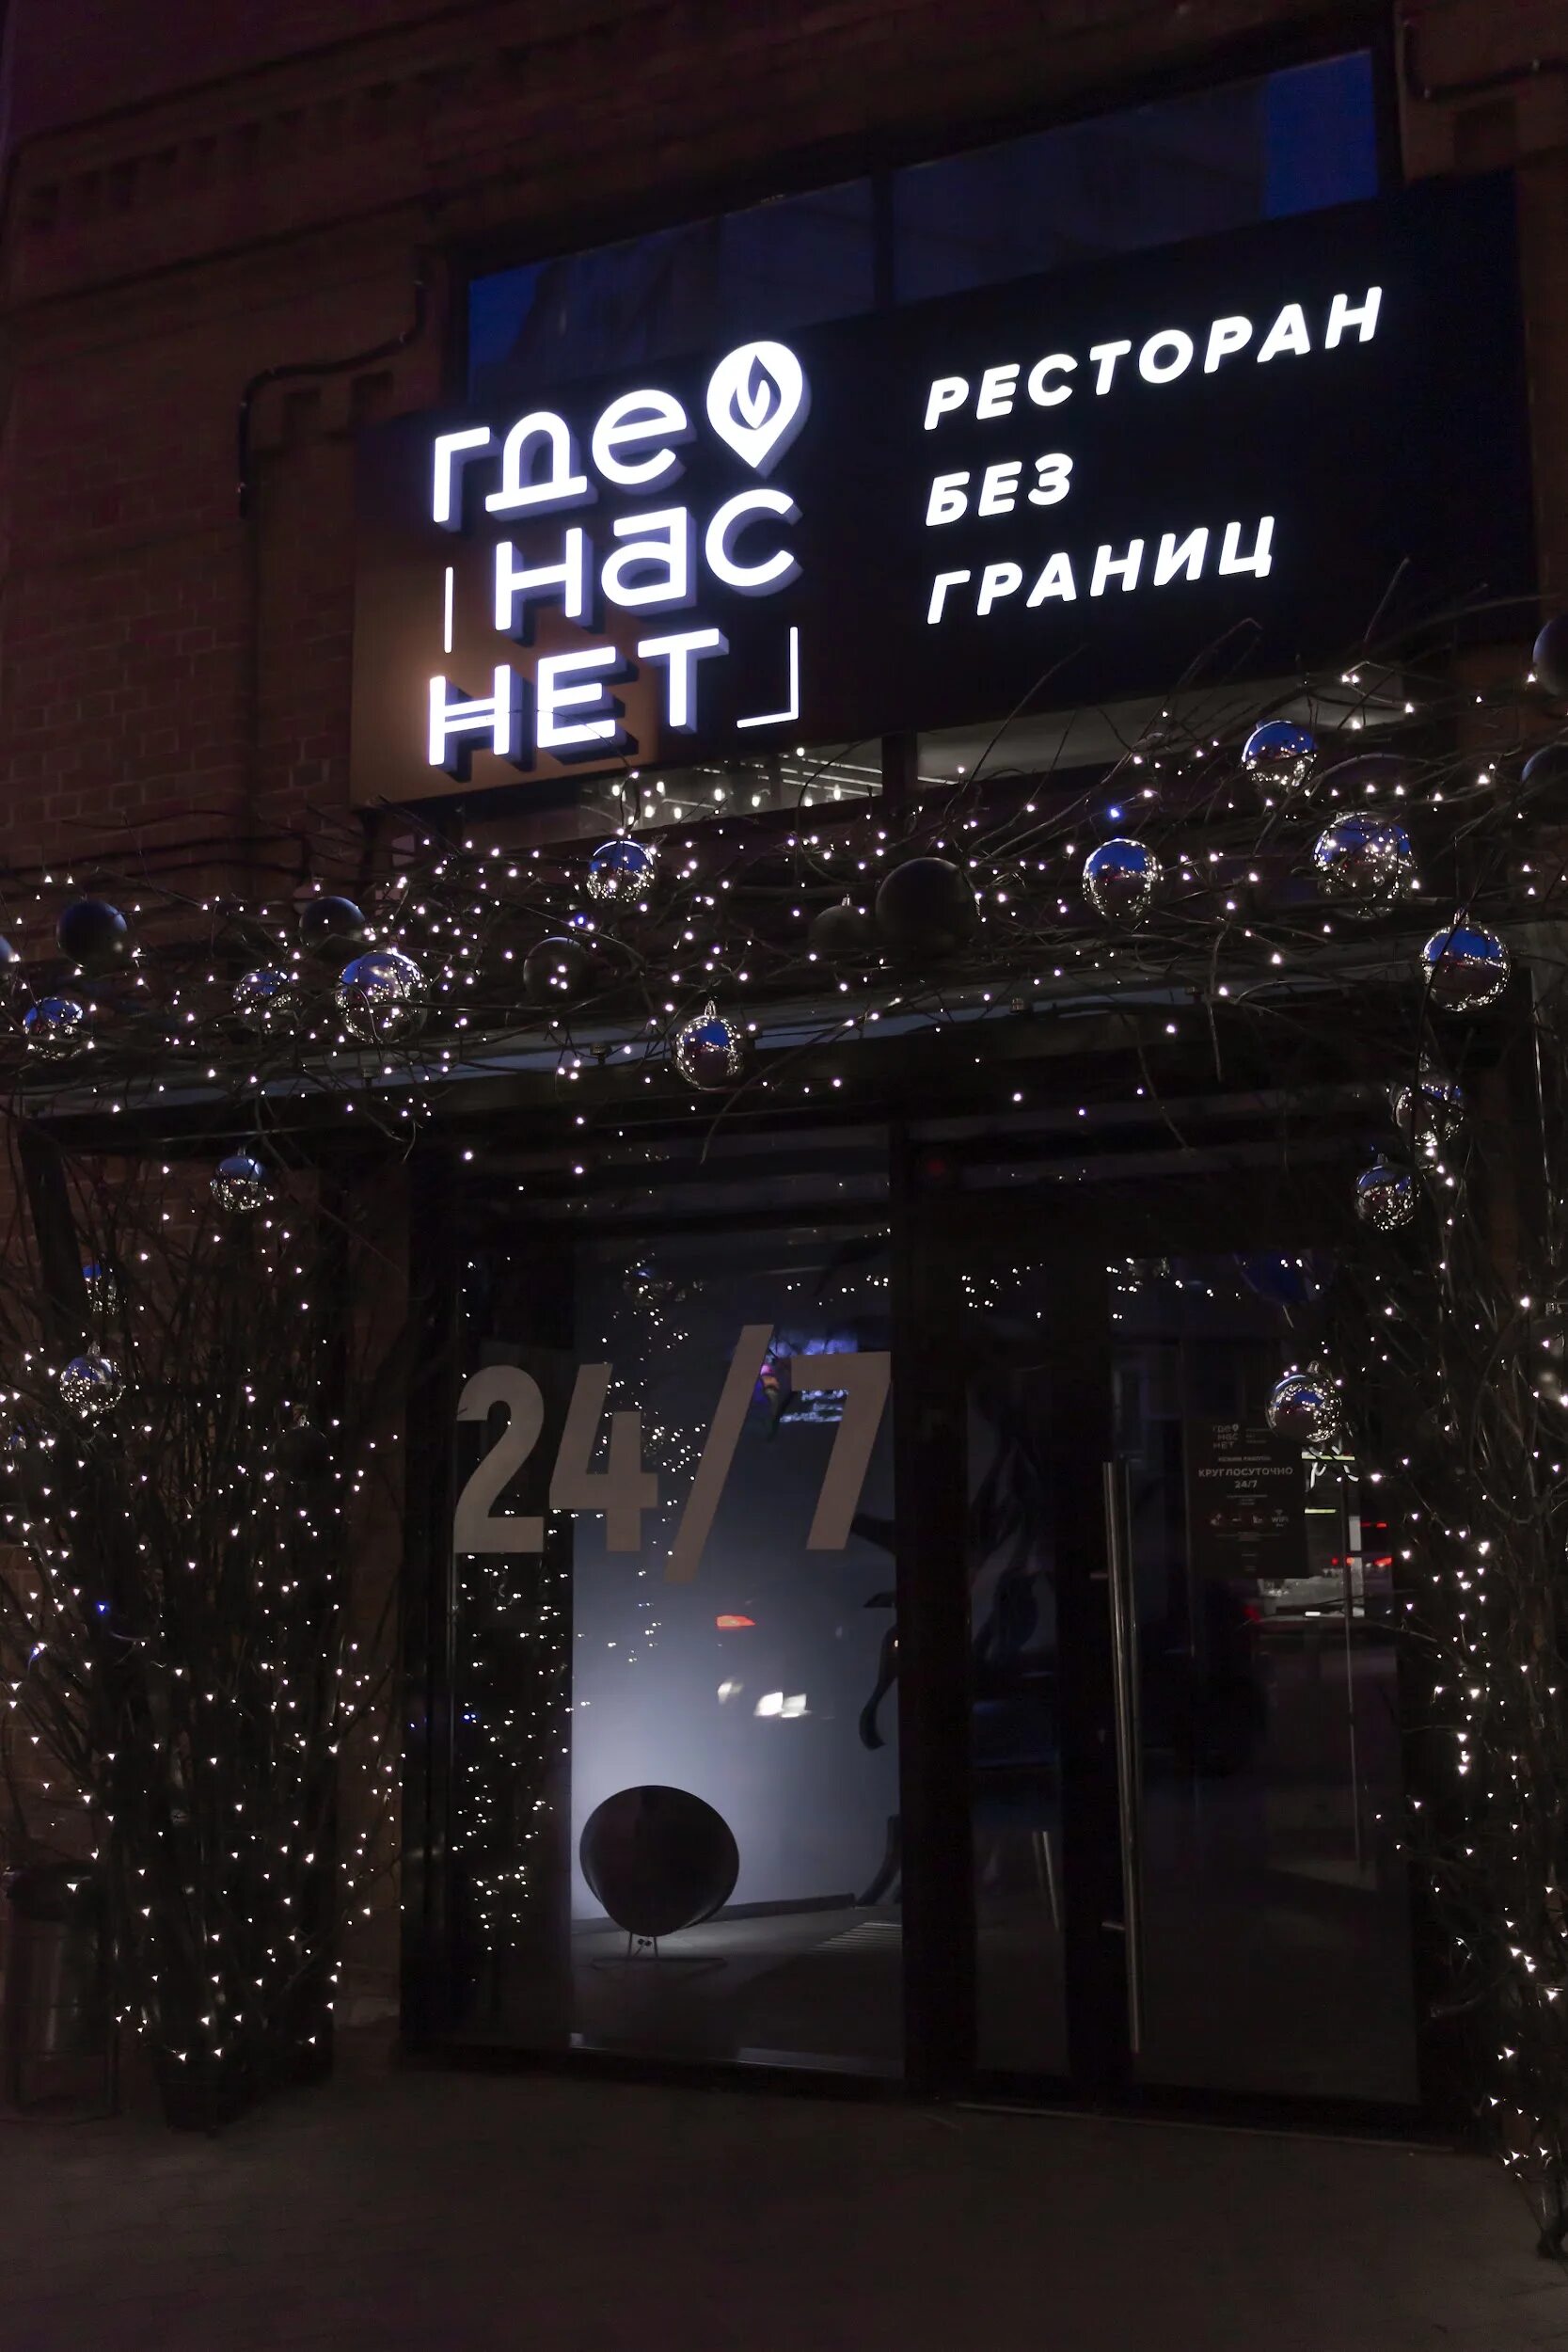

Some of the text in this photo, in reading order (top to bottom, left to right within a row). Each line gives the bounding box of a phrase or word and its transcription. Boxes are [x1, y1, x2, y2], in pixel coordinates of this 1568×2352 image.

[924, 286, 1383, 431] РЕСТОРАН
[926, 453, 1074, 527] БЕЗ
[927, 516, 1275, 625] ГРАНИЦ
[428, 628, 721, 766] НЕТ
[453, 1324, 892, 1582] 24/7
[1197, 1467, 1293, 1477] КРУГЛОСУТОЧНО
[1234, 1480, 1258, 1488] 24/7
